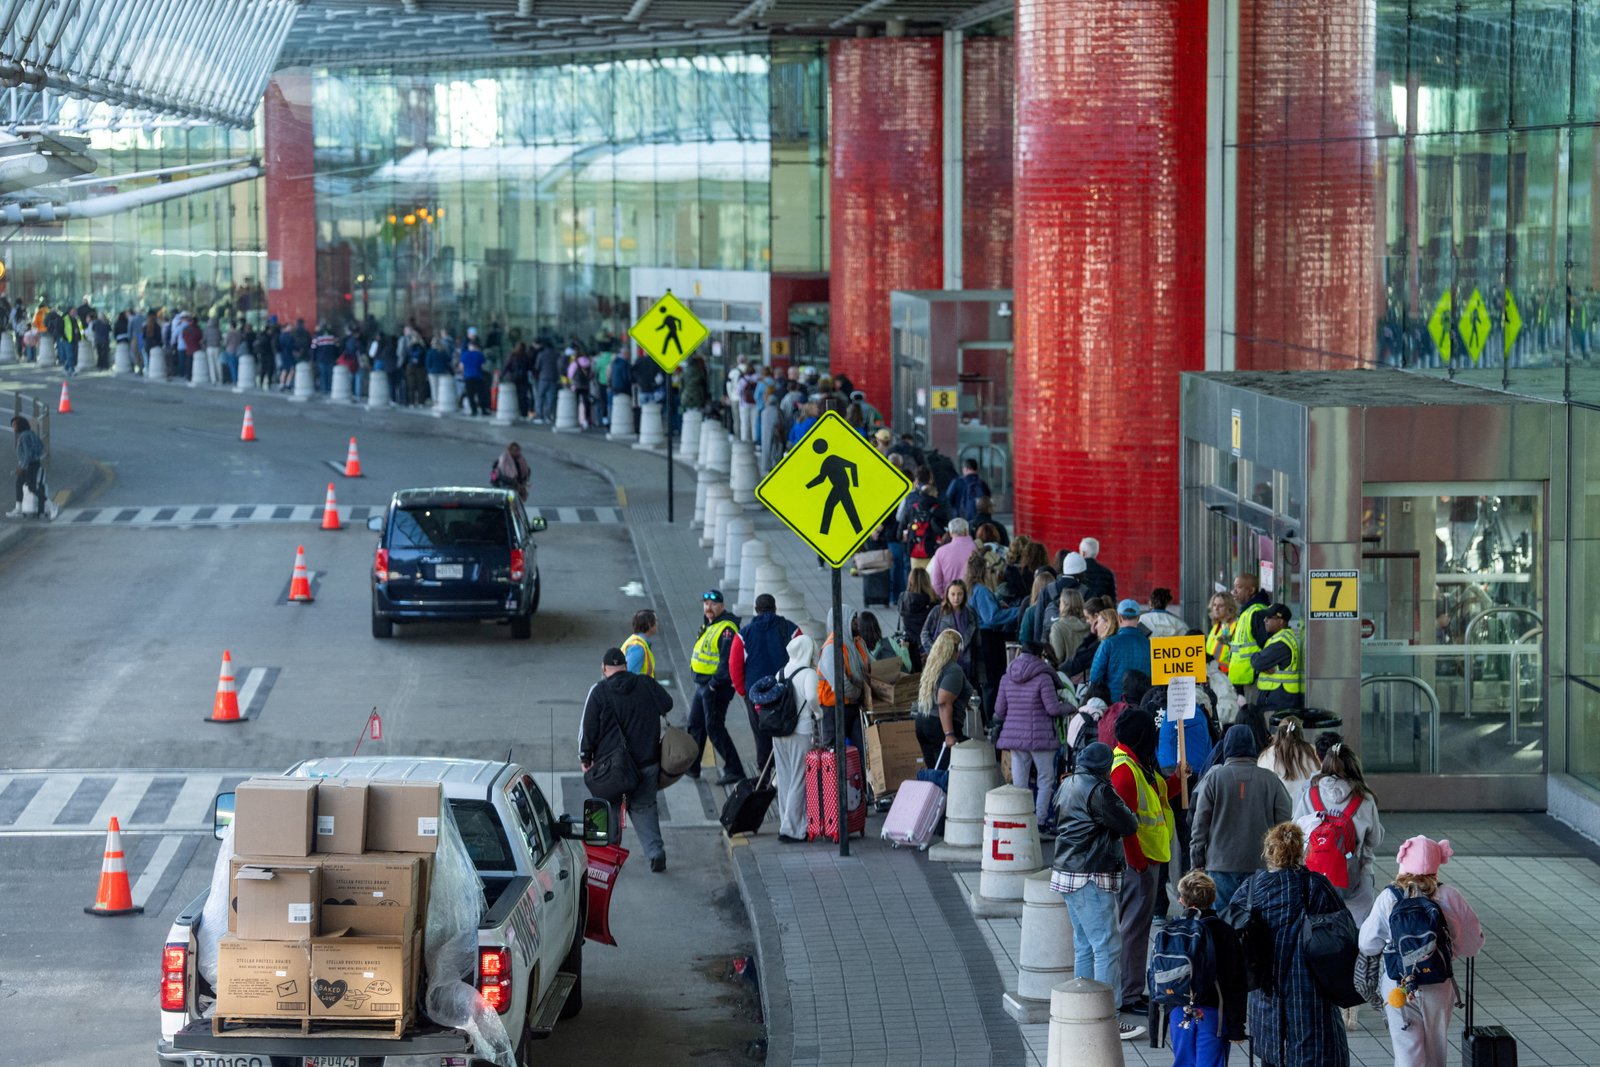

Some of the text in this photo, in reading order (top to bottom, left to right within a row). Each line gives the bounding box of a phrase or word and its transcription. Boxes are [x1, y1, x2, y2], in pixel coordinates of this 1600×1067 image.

[940, 391, 949, 408] 8
[1325, 580, 1343, 609] 7
[1153, 646, 1203, 659] END OF
[1163, 662, 1194, 674] LINE
[319, 984, 341, 993] BAKED
